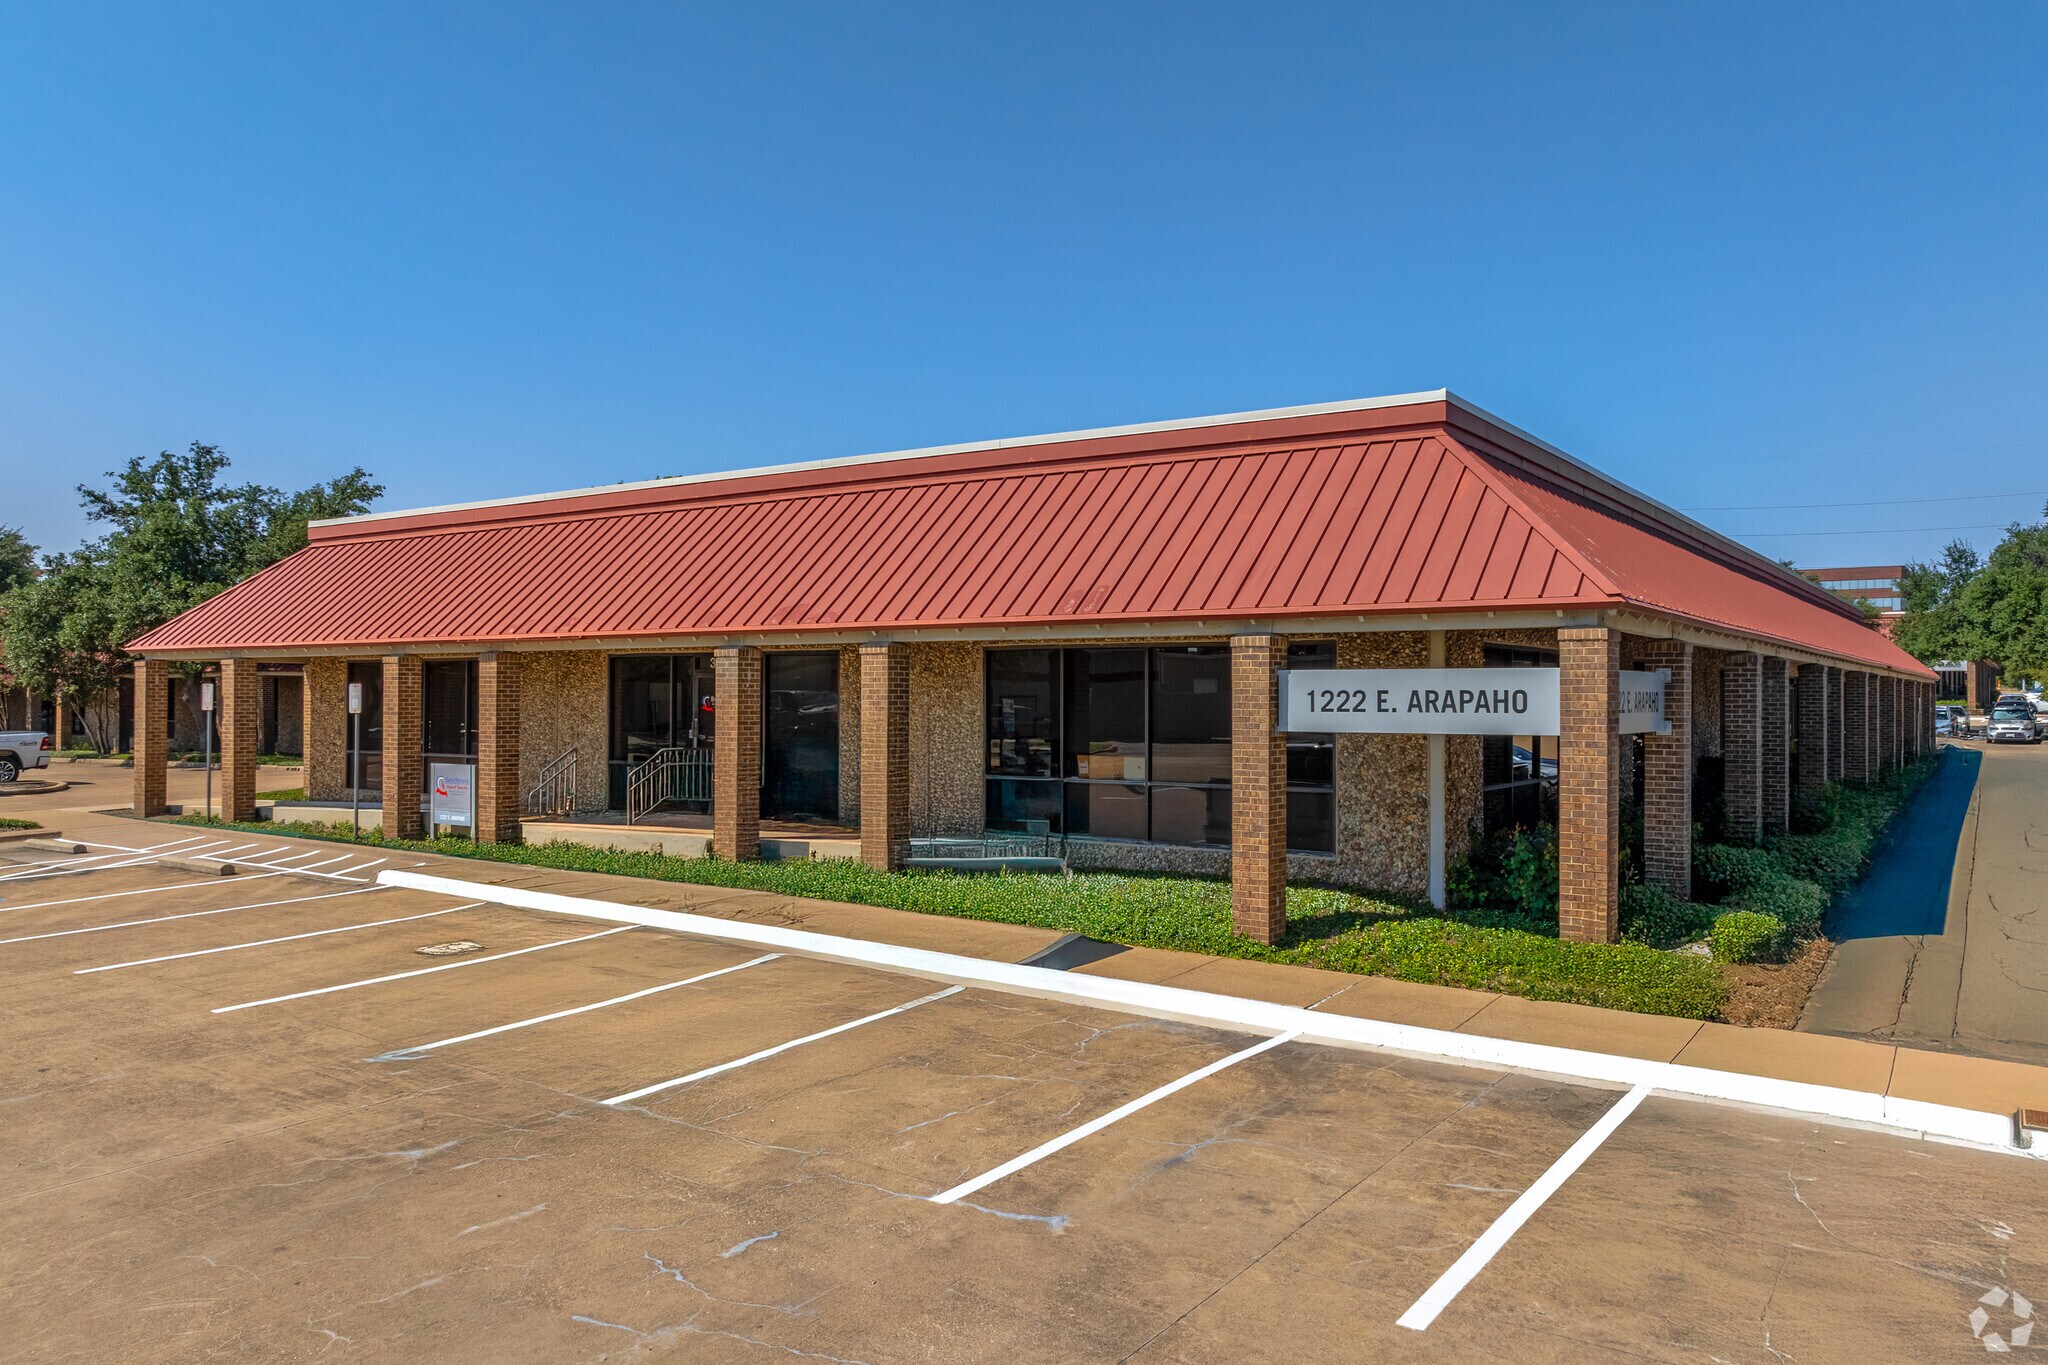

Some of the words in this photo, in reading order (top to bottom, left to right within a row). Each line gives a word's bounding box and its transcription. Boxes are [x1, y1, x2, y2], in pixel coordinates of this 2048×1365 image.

[1307, 689, 1367, 713] 1222
[1376, 689, 1397, 713] E.
[1407, 689, 1528, 714] ARAPAHO
[1634, 691, 1659, 713] ARAPAHO
